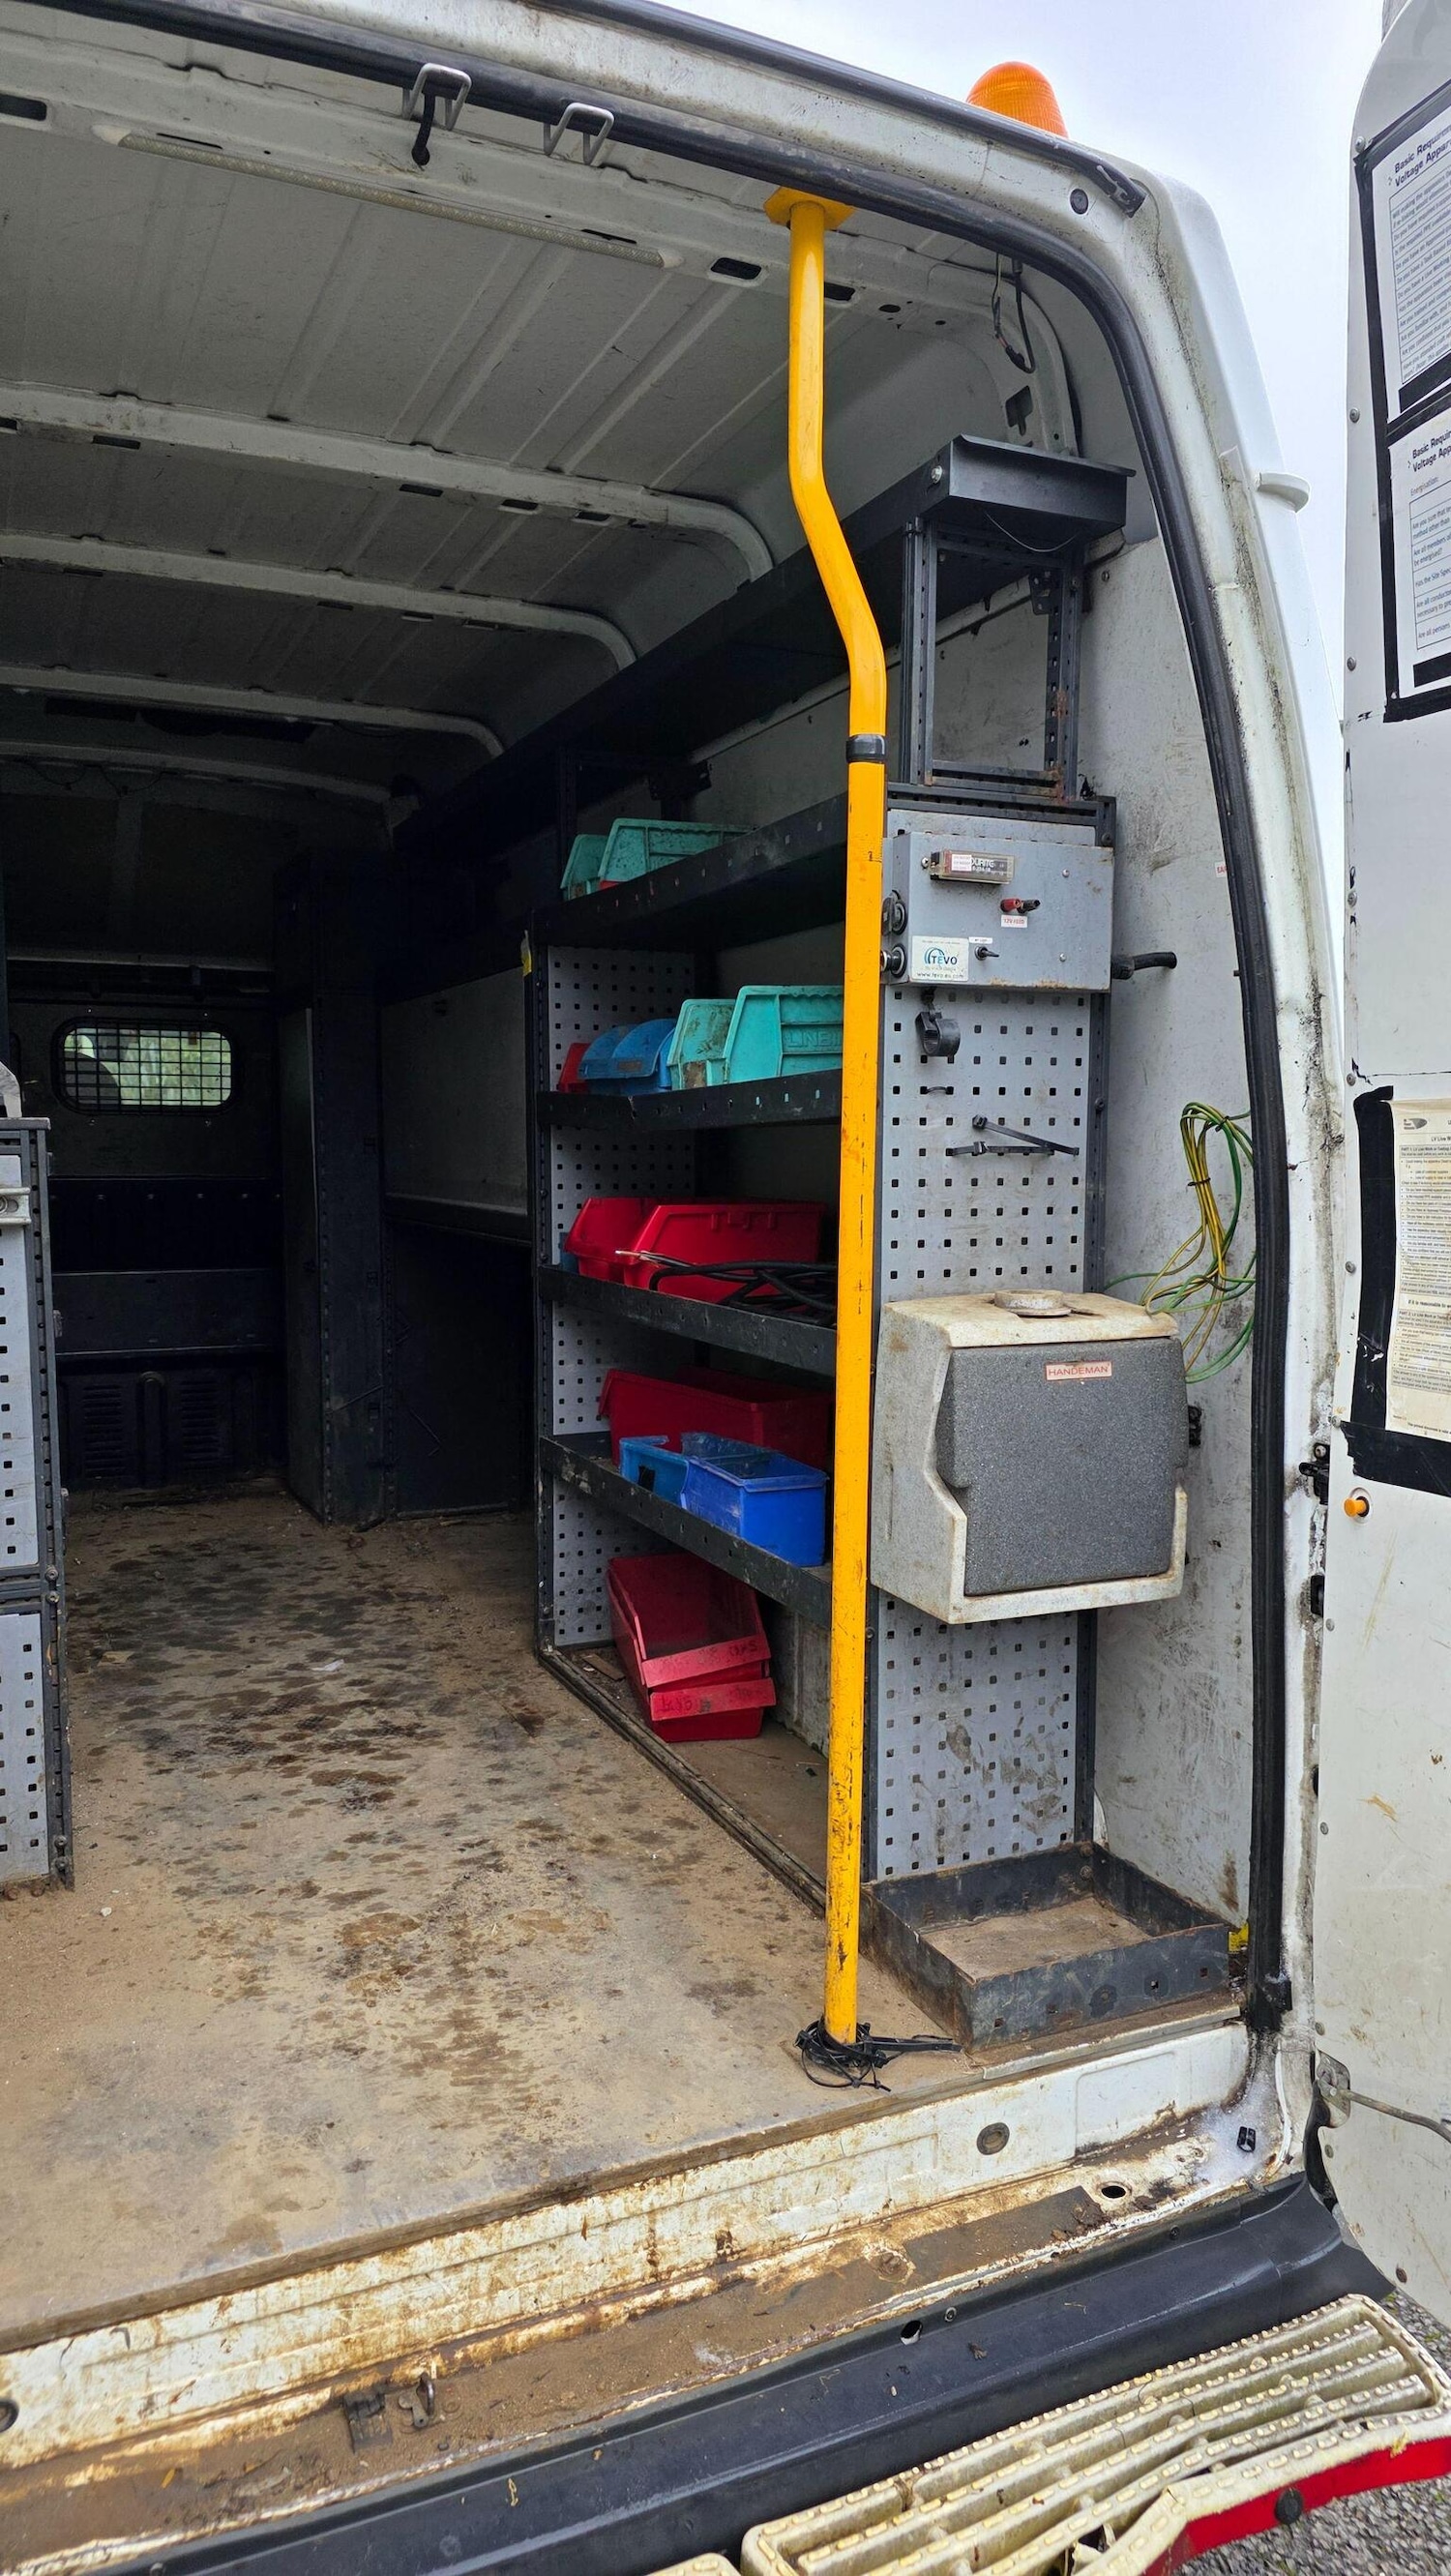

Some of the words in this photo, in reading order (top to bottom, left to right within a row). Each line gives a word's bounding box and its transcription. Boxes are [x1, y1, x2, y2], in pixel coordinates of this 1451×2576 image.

[1394, 153, 1414, 173] Basic
[1395, 161, 1423, 187] Voltage
[1412, 443, 1429, 459] Basic
[1413, 454, 1436, 472] Voltage
[1049, 1365, 1109, 1377] HANDEMAN
